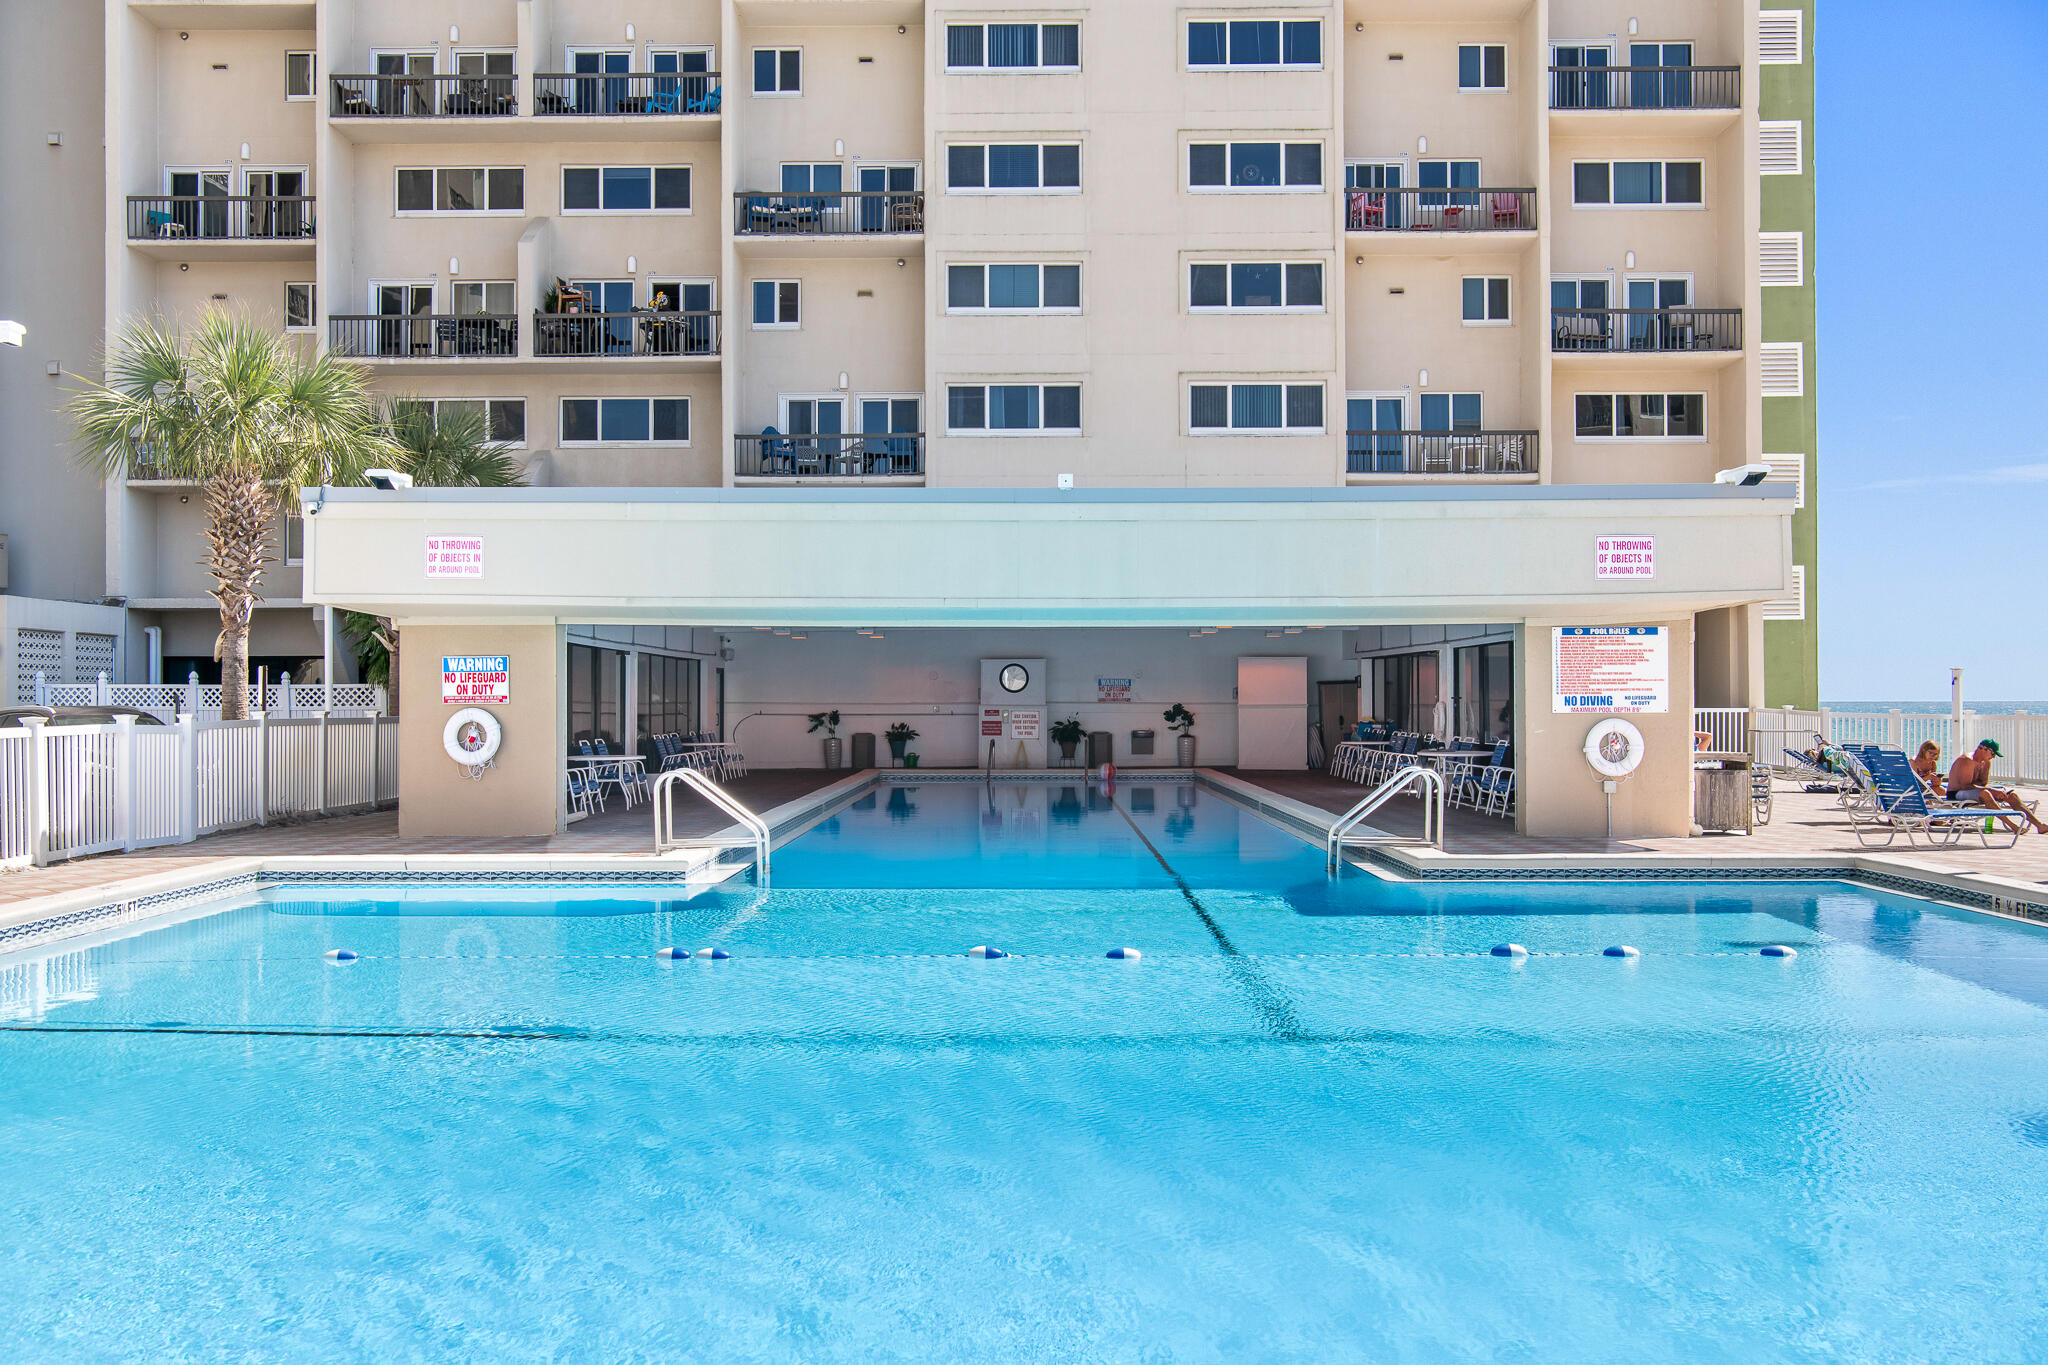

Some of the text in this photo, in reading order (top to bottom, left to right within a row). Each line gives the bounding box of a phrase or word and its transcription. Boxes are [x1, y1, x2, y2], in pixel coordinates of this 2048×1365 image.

[429, 541, 481, 550] NO THROWING
[1598, 541, 1652, 550] NO THROWING
[429, 553, 481, 562] OF OBJECTS IN
[1598, 554, 1652, 563] OF OBJECTS IN
[429, 566, 481, 574] OR AROUND POOL
[1598, 566, 1652, 575] OR AROUND POOL
[1590, 627, 1630, 635] POOL RULES
[447, 657, 503, 672] WARNING
[444, 672, 506, 683] NO LIFEGUARD
[456, 684, 495, 695] ON DUTY
[1564, 695, 1613, 707] NO DIVING
[128, 901, 136, 912] FT
[2016, 901, 2027, 914] FT
